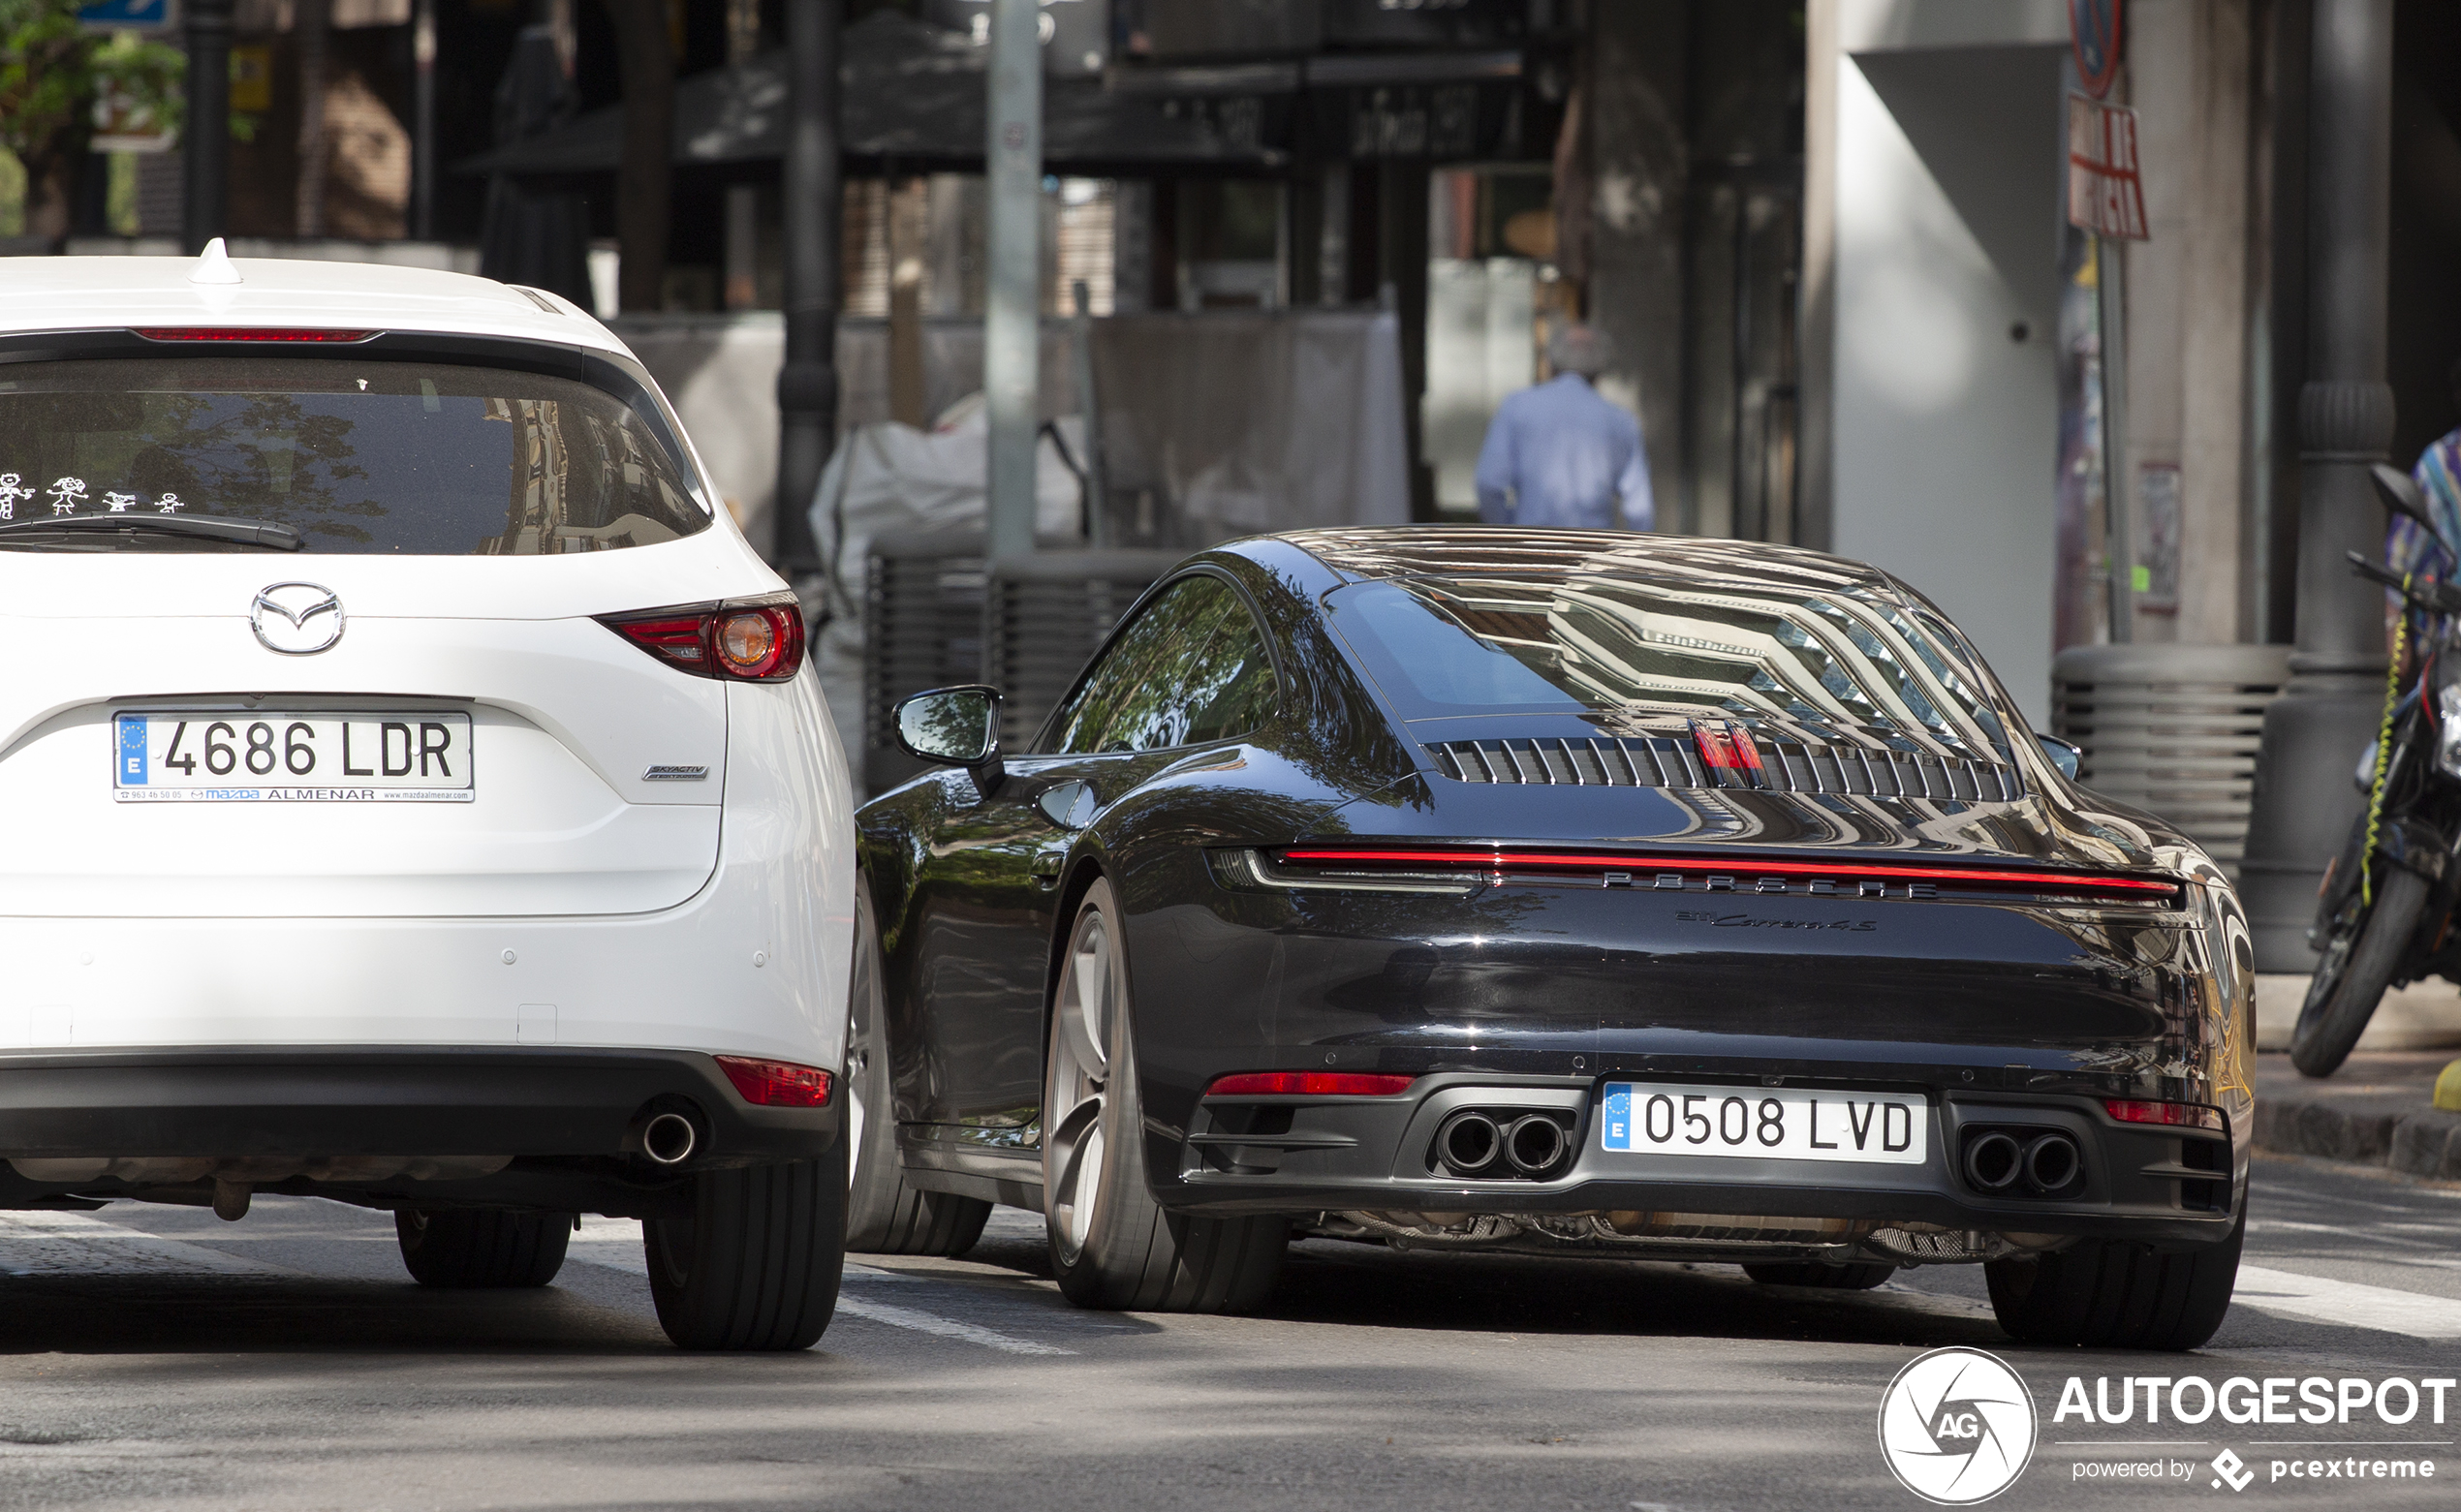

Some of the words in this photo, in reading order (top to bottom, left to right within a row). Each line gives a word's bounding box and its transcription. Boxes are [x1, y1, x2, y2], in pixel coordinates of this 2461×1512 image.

[165, 721, 316, 776] 4686
[342, 721, 452, 777] LDR
[127, 757, 140, 774] E
[131, 790, 146, 799] 963
[148, 790, 158, 799] 46
[160, 790, 171, 799] 50
[172, 790, 182, 799] 05
[205, 789, 260, 799] mazda
[267, 789, 375, 799] ALMENAR
[383, 790, 469, 800] www.mazdaalmenar.com
[1602, 871, 1938, 900] PORSCHE
[1710, 913, 1824, 930] Carrera
[1611, 1122, 1625, 1138] E
[1645, 1093, 1786, 1148] 0508
[1809, 1098, 1912, 1153] LVD
